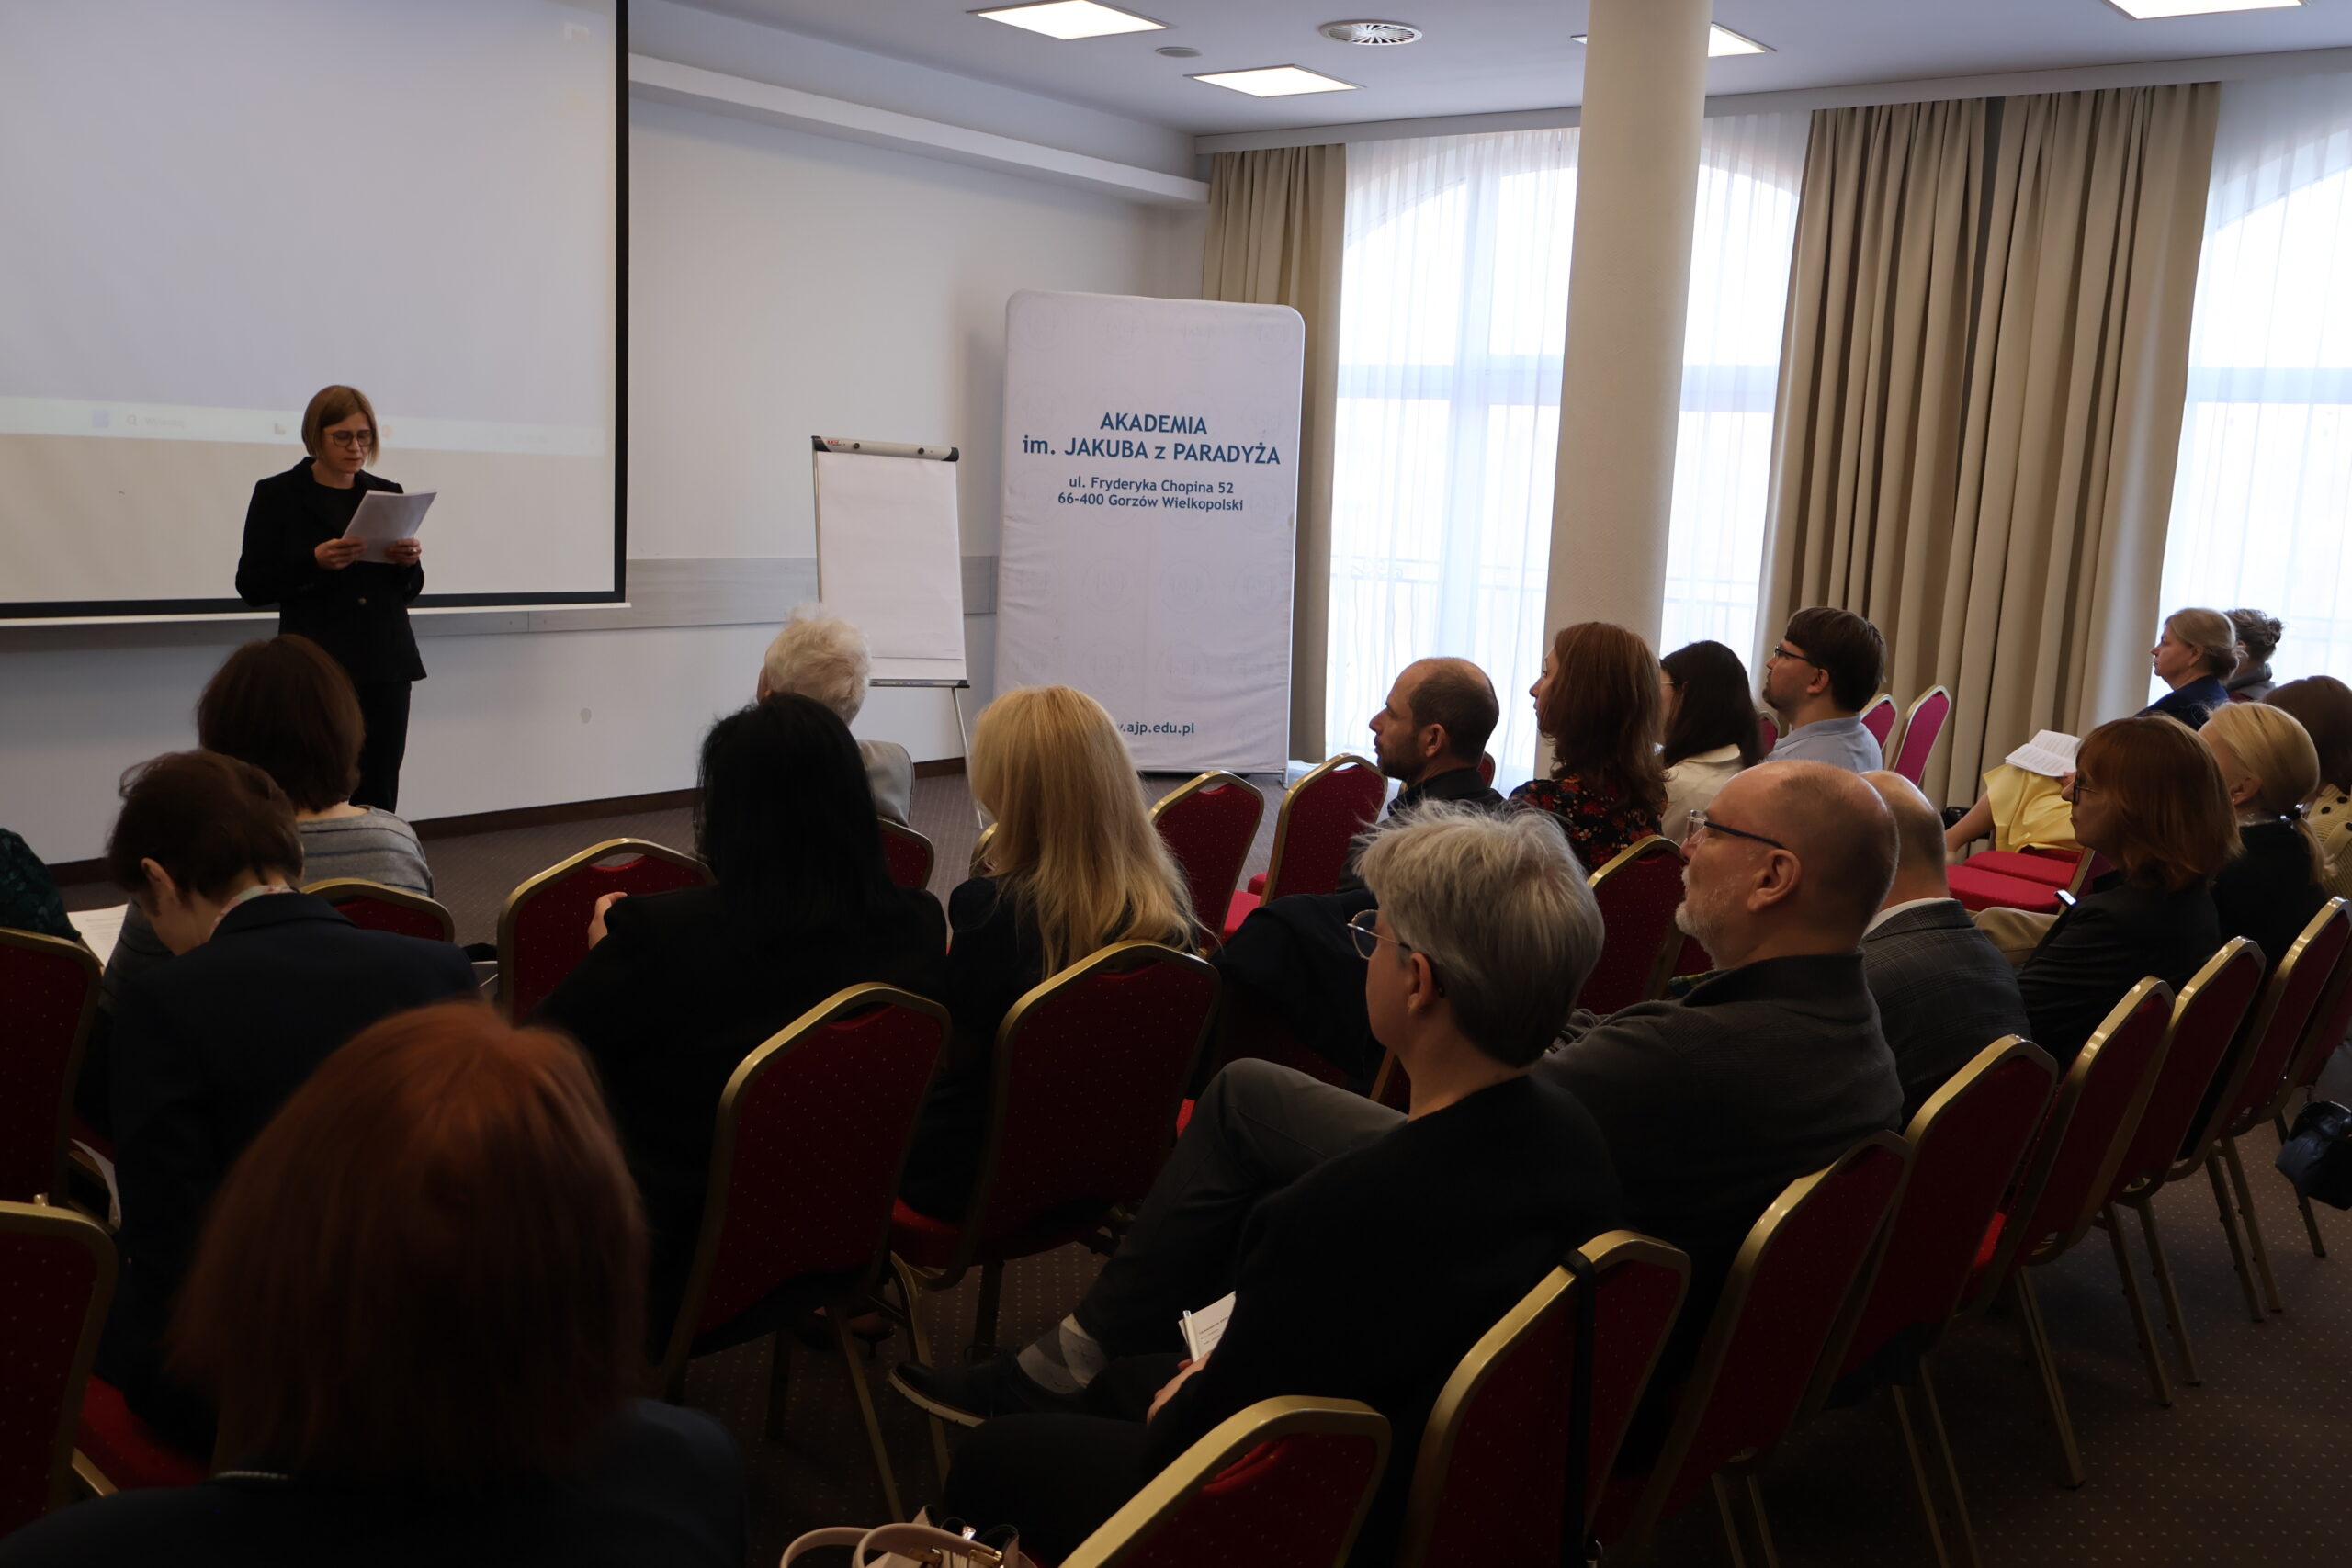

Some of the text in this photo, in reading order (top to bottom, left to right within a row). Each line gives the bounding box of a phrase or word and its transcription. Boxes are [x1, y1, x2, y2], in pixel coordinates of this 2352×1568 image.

[1100, 412, 1208, 435] AKADEMIA
[1023, 434, 1282, 466] im. JAKUBA z PARADYŻA
[1069, 475, 1235, 495] ul. Fryderyka Chopina 52
[1057, 492, 1245, 513] 66-400 Gorzów Wielkopolski
[1117, 721, 1195, 737] .ajp.edu.pl
